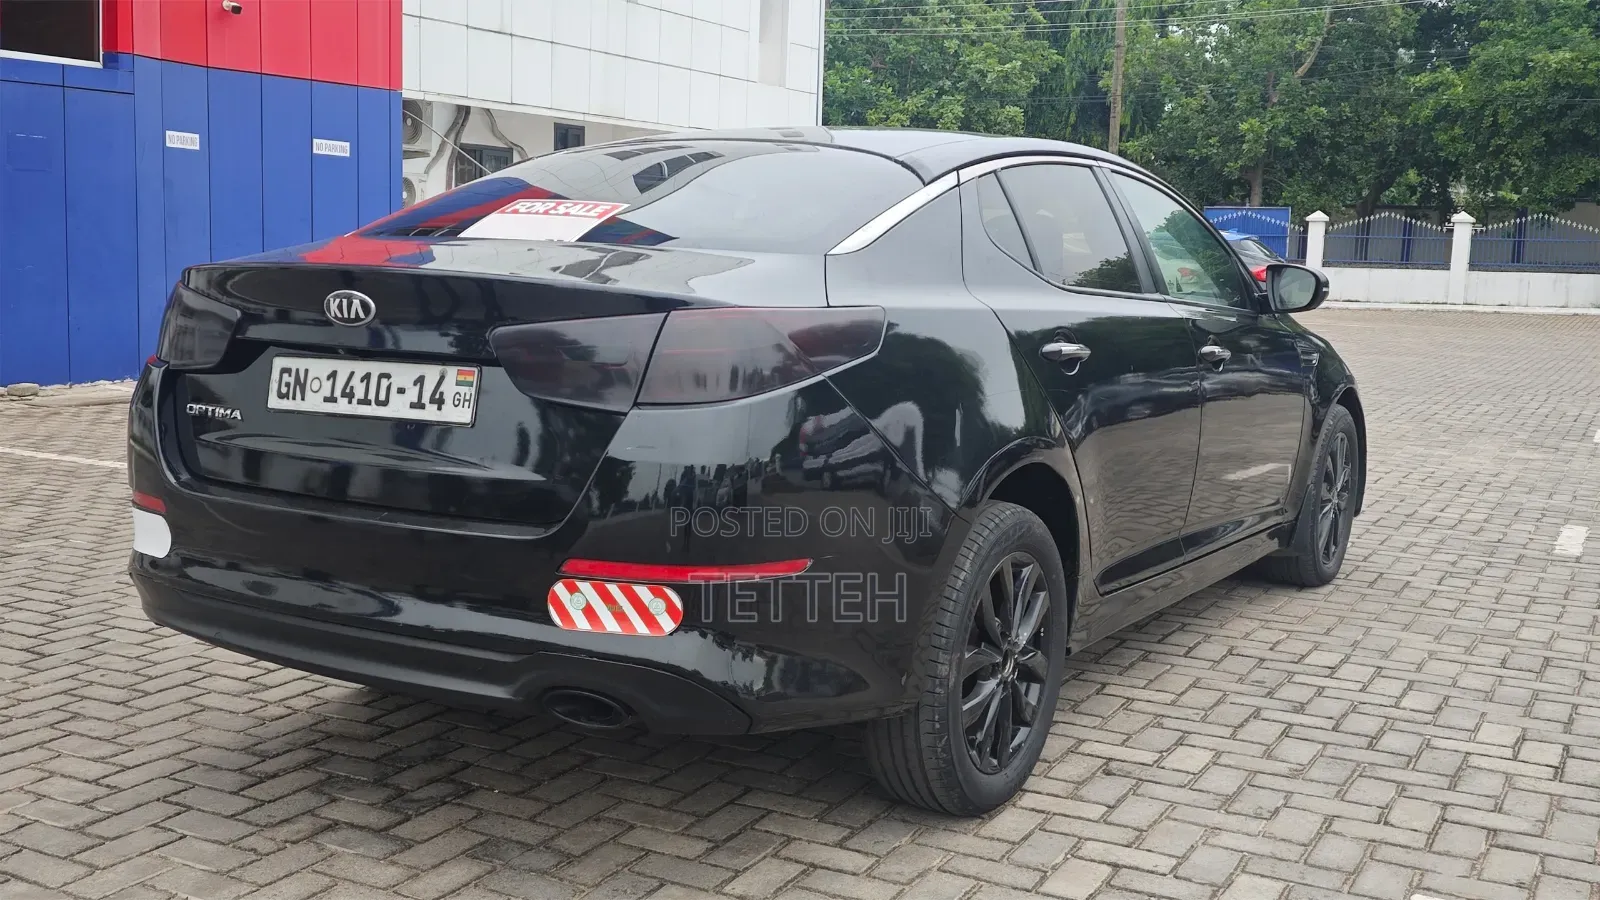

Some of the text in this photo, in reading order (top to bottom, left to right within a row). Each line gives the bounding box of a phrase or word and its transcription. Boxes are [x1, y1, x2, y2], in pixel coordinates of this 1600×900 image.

[168, 134, 198, 147] NO PARKING
[315, 141, 348, 154] NO PARKING
[507, 202, 608, 217] FOR SALE
[329, 298, 365, 319] KIA
[277, 367, 308, 401] GN
[452, 391, 472, 409] GH
[186, 403, 242, 420] OPTIMA
